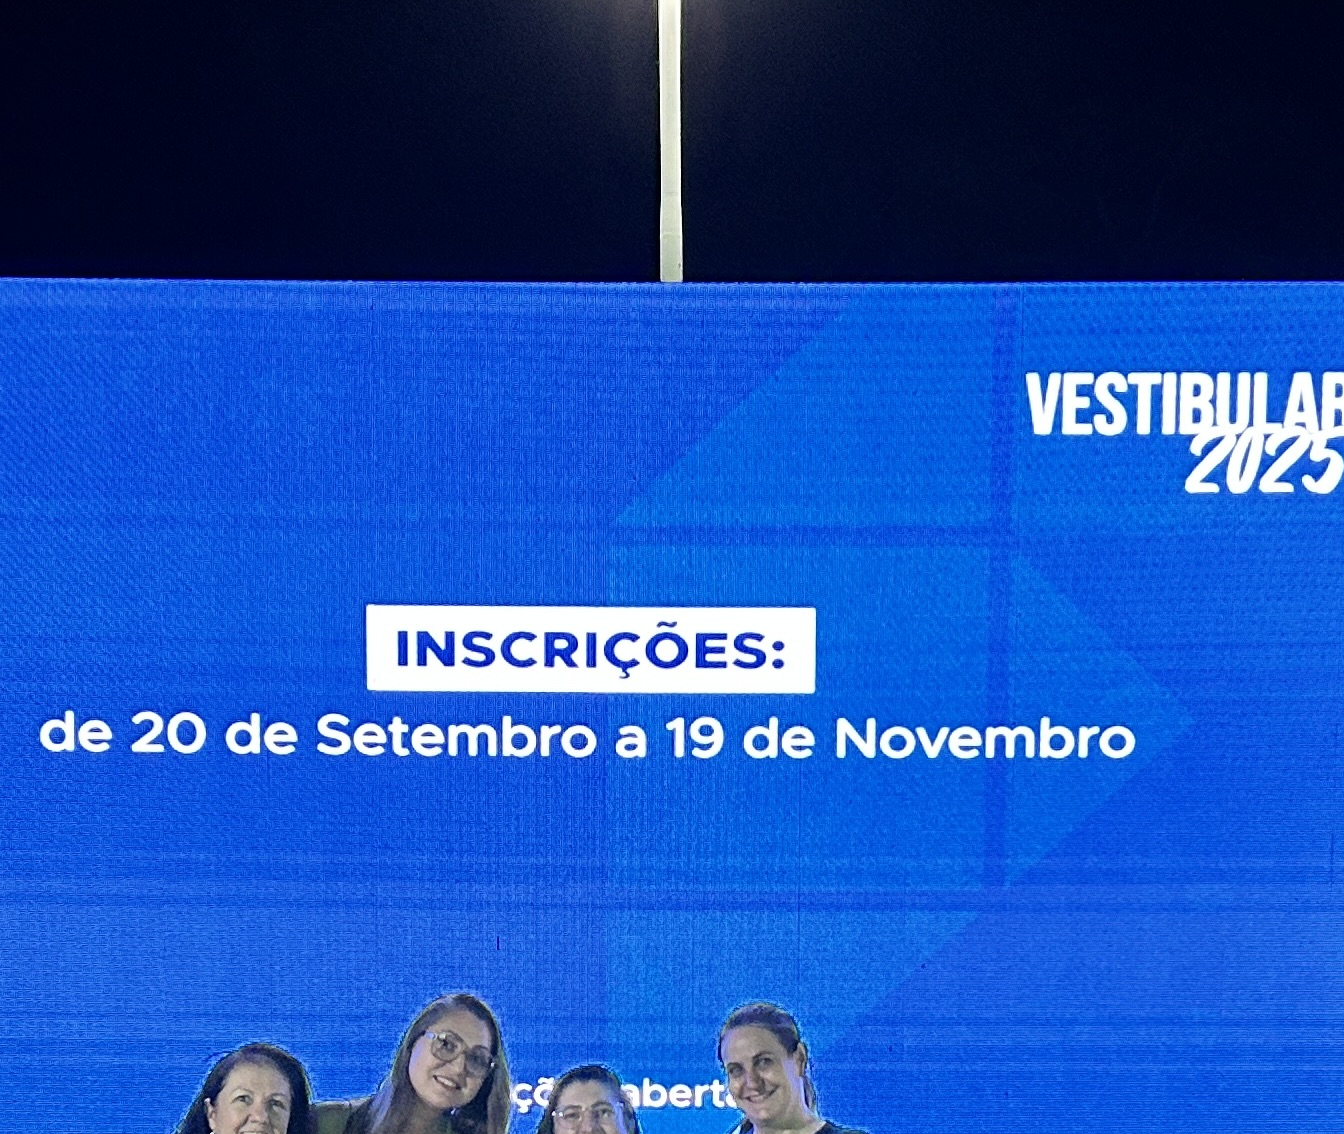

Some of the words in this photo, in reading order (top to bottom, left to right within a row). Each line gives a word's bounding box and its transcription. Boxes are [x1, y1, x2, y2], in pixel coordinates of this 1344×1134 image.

[396, 621, 785, 679] INSCRIÇÕES:
[39, 710, 113, 753] de
[131, 711, 207, 754] 20
[225, 712, 298, 755] de
[316, 713, 597, 758] Setembro
[615, 725, 647, 759] a
[665, 716, 724, 759] 19
[743, 716, 815, 759] de
[836, 716, 1136, 759] Novembro
